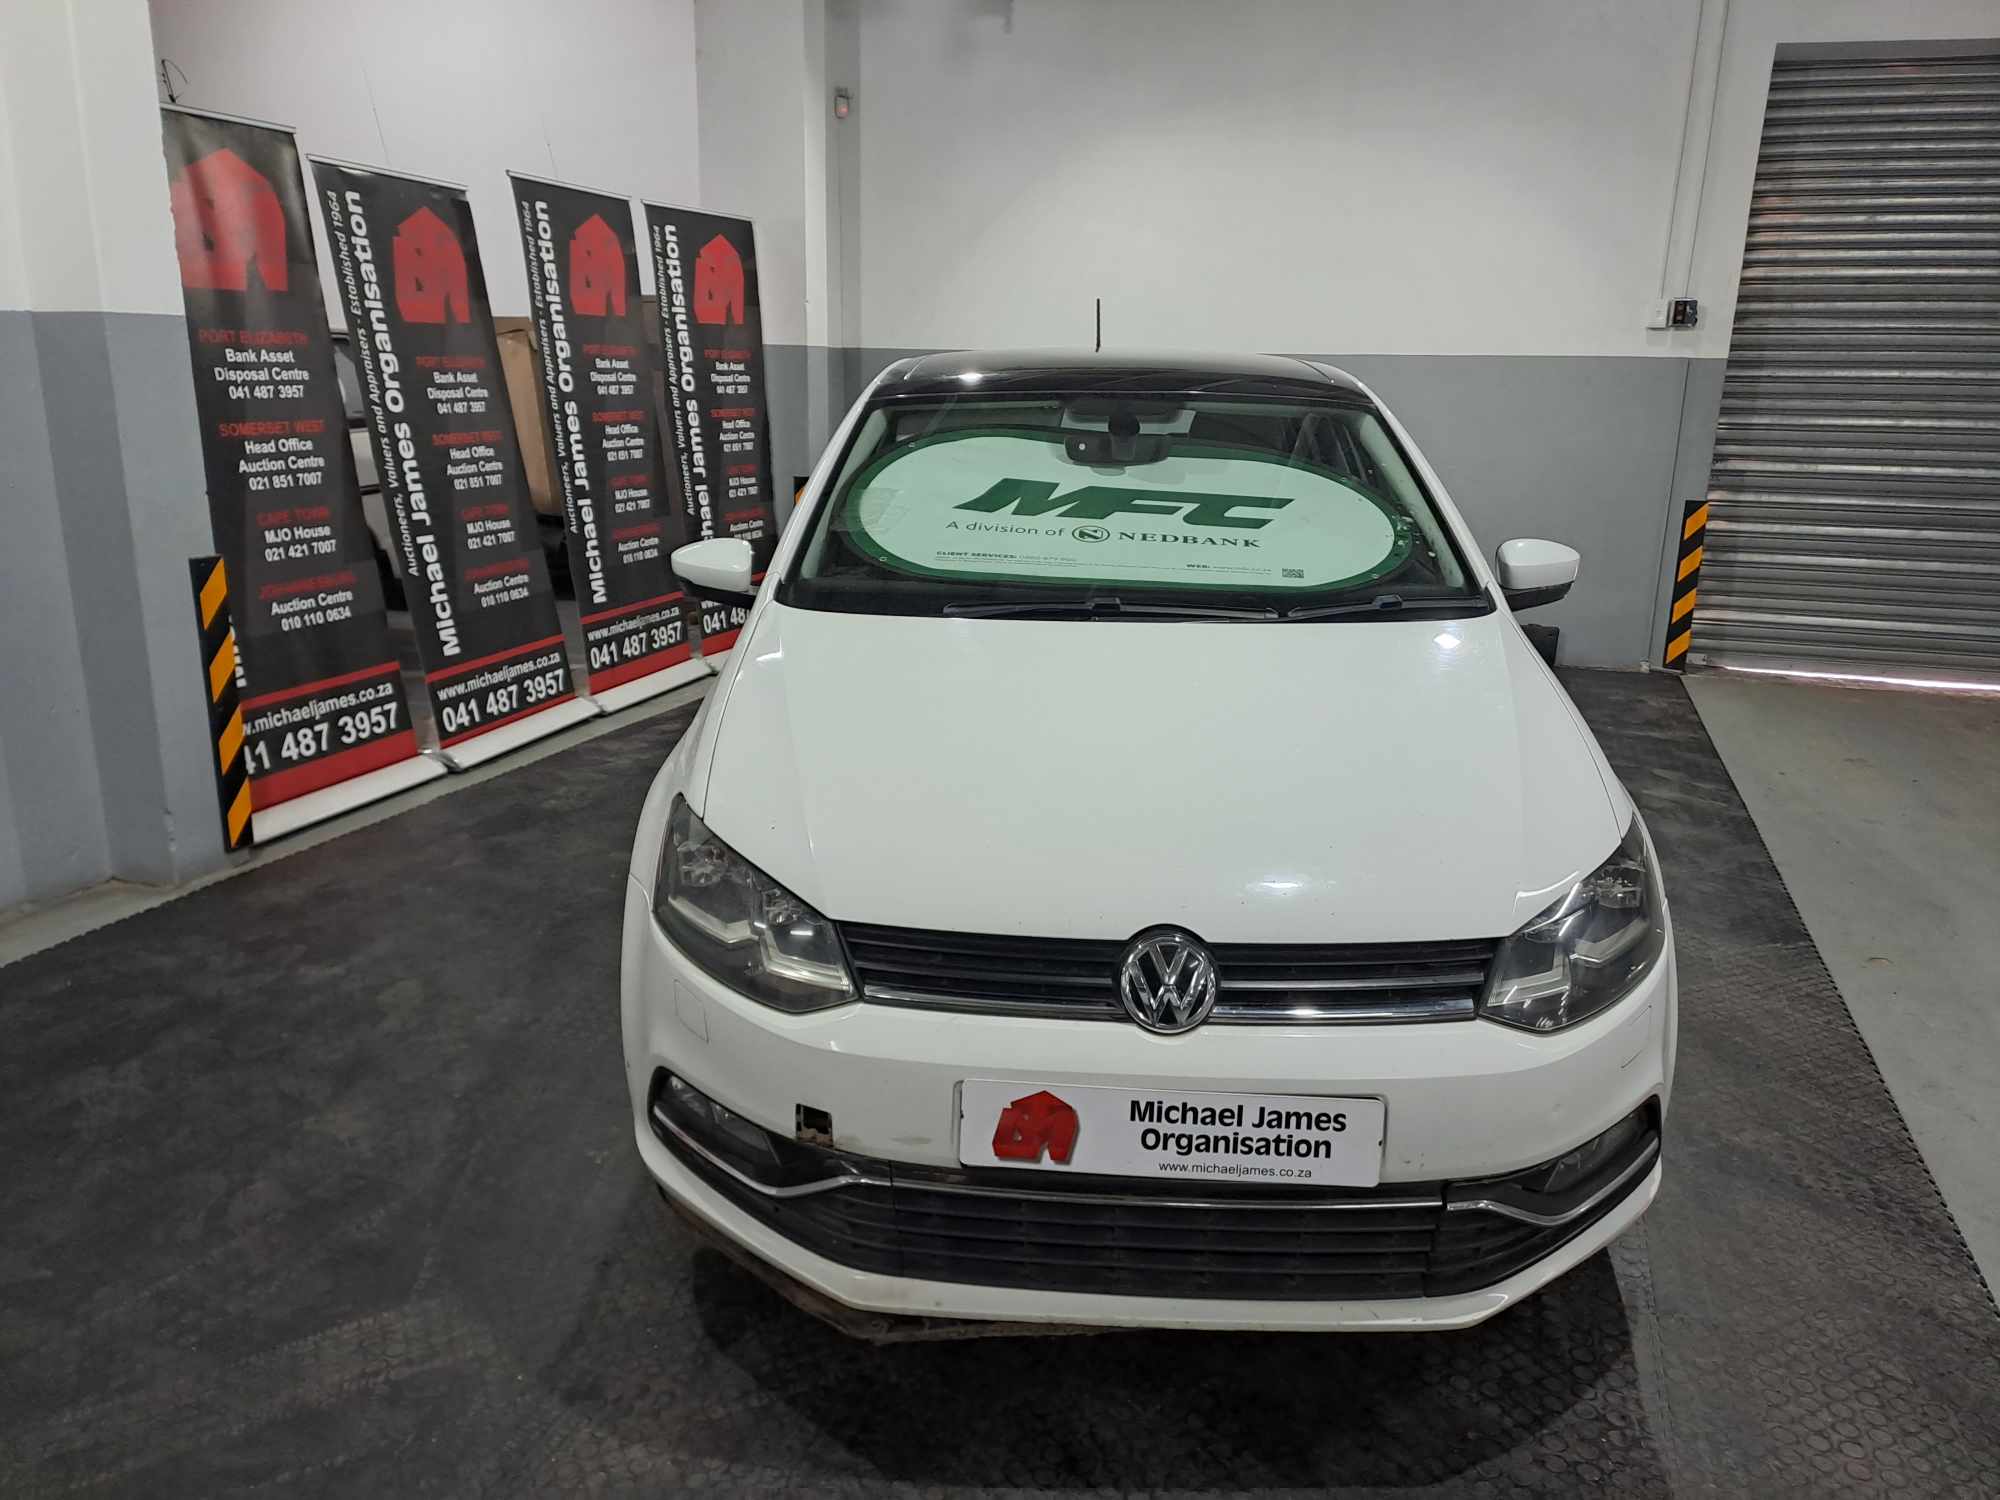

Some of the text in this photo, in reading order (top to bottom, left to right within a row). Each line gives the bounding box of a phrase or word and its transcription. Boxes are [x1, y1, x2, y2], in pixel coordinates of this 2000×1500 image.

[521, 200, 533, 232] 1964
[526, 233, 545, 308] Established
[664, 224, 696, 392] Organisation
[225, 348, 295, 363] Bank Asset
[214, 367, 309, 383] Disposal Centre
[326, 190, 420, 577] Auctioneers, Valuers and Appraisers Established 1964
[432, 371, 456, 384] Bank
[229, 385, 304, 400] 041 487 3957
[426, 387, 464, 401] Disposal
[535, 200, 607, 605] Michael James Organisation
[546, 381, 559, 410] and
[436, 403, 452, 415] 041
[345, 190, 461, 657] Michael James Organisation
[554, 411, 567, 457] Valuers
[244, 438, 313, 454] Head Office
[686, 399, 707, 479] James
[239, 455, 325, 473] Auction Centre
[449, 446, 495, 460] Head Office
[249, 472, 322, 490] 021 851 7007
[447, 463, 478, 476] Auction
[952, 477, 1296, 530] MFC
[264, 525, 331, 544] MJO House
[485, 518, 512, 531] House
[945, 521, 960, 530] A
[966, 521, 1040, 537] division
[1045, 526, 1065, 538] of
[1119, 532, 1261, 549] NEDBANK
[265, 540, 336, 562] 021 421 7007
[467, 537, 482, 550] 021
[482, 534, 496, 546] 421
[473, 574, 529, 595] Auction Centre
[271, 590, 353, 616] Auction Centre
[281, 616, 301, 632] 010
[303, 611, 324, 626] 110
[587, 606, 680, 642] www.michaeljames.co.za
[703, 610, 727, 634] 041
[590, 621, 682, 670] 041 487 3957
[437, 652, 561, 701] www.michaeljames.co.za
[442, 668, 565, 732] 041 487 3957
[280, 722, 329, 761] 487
[338, 702, 398, 744] 3957
[1129, 1100, 1348, 1132] Michael James
[1140, 1128, 1332, 1159] Organisation
[1159, 1161, 1312, 1179] www.michaeljames.co.za
